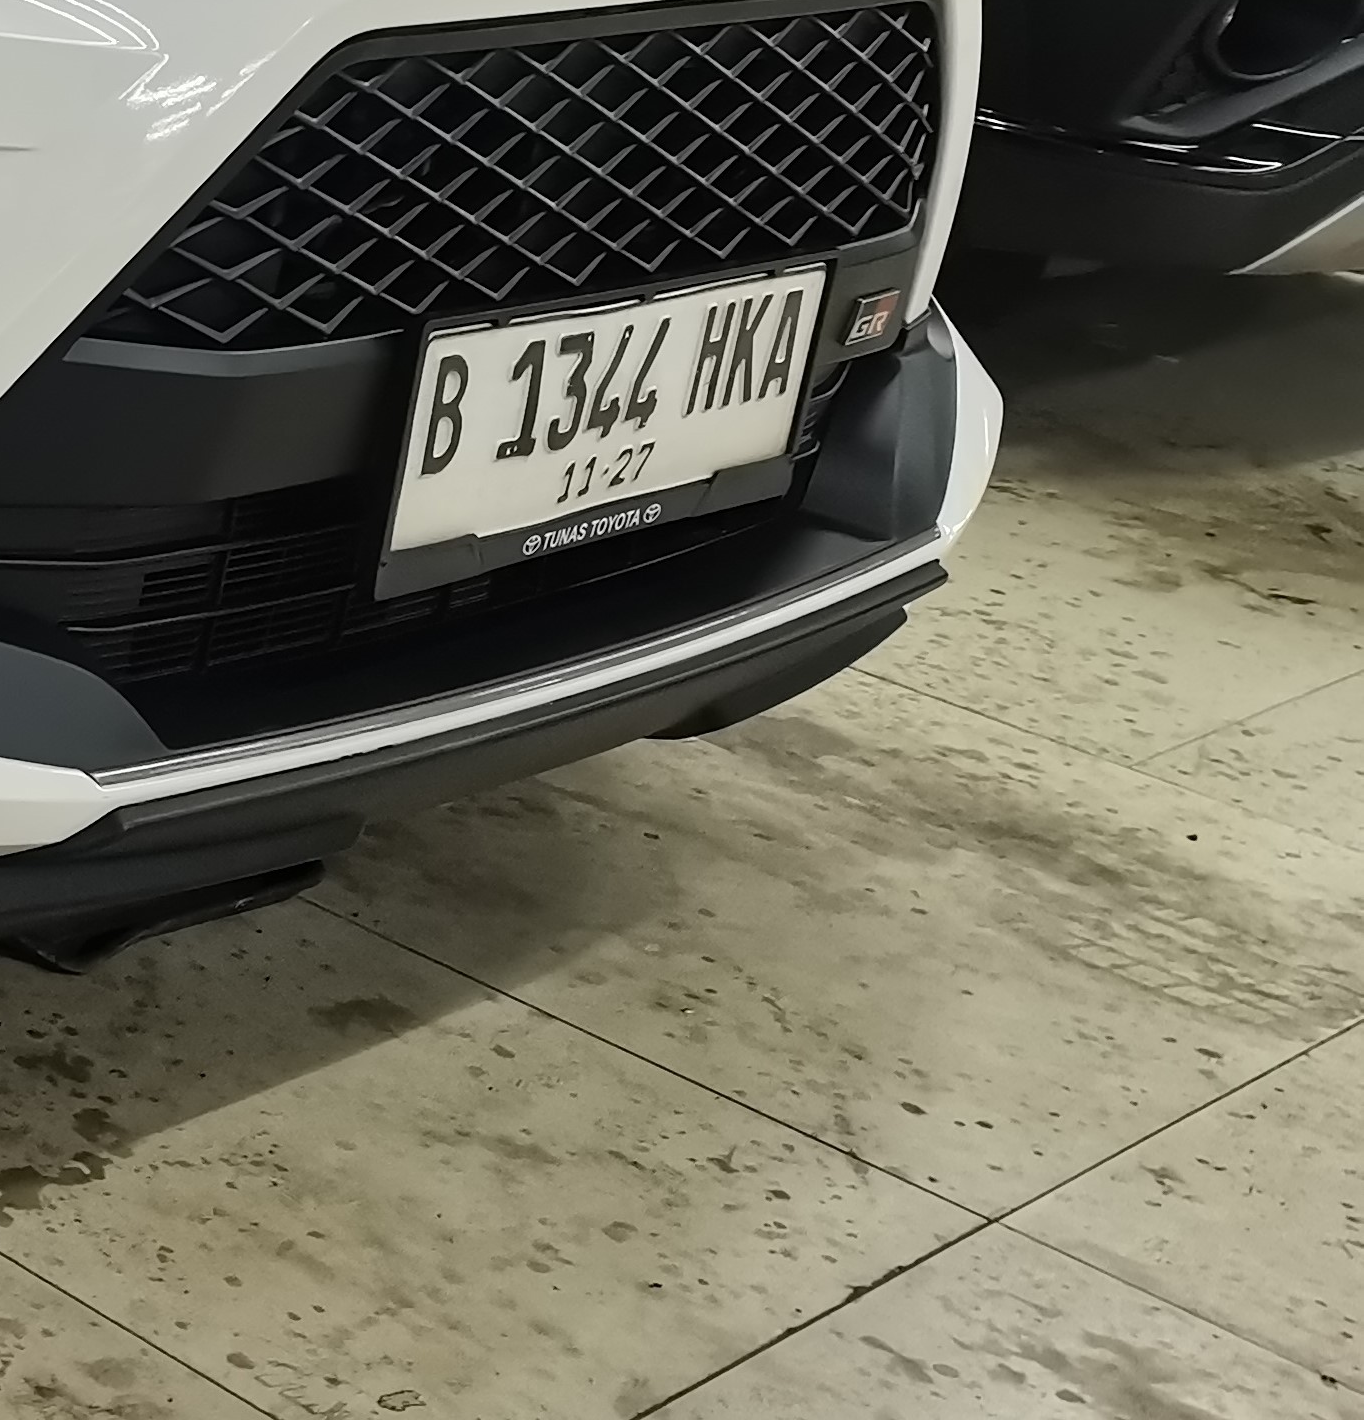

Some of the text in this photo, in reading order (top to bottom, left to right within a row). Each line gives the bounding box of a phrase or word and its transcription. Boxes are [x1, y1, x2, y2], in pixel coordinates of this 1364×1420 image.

[420, 289, 804, 475] B 1344 HKA
[543, 508, 641, 551] TUNAS TOYOTA
